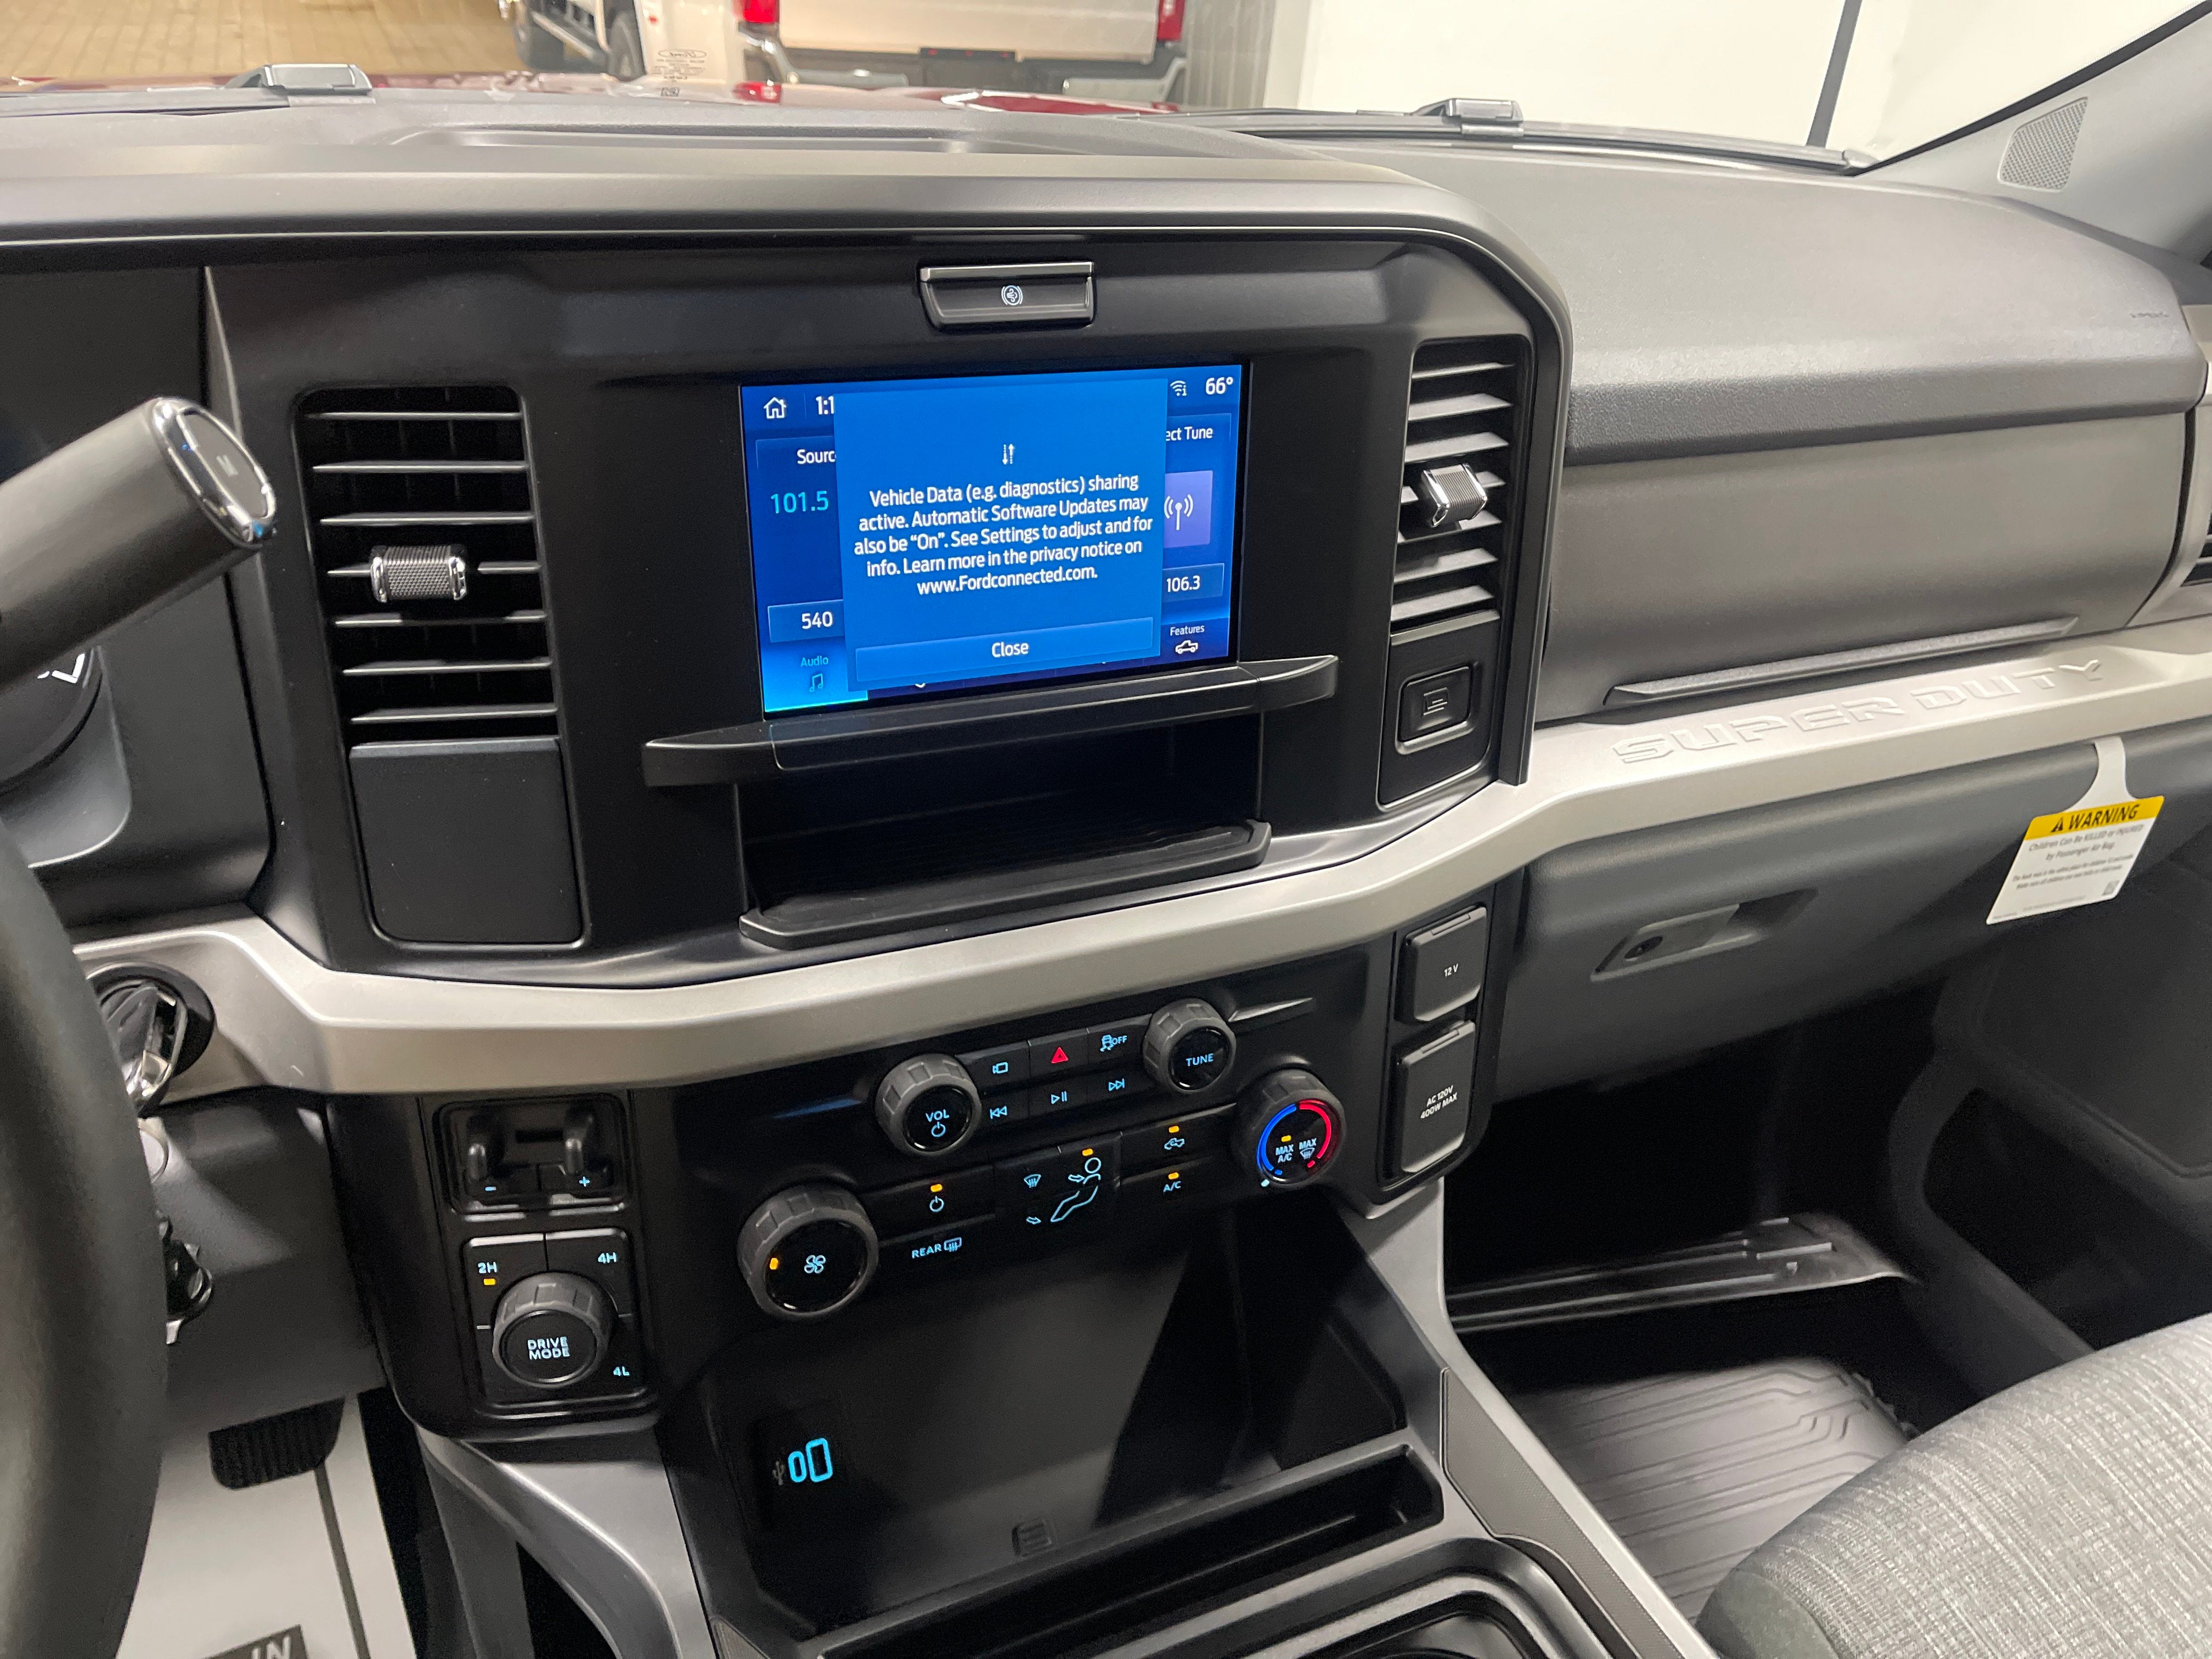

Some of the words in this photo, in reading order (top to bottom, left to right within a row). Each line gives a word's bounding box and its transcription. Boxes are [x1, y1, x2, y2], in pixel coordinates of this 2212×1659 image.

[1205, 376, 1234, 395] 66°
[1184, 426, 1214, 440] Tune
[797, 449, 836, 465] Sourc
[869, 487, 924, 507] Vehicle
[927, 485, 963, 504] Data
[966, 483, 997, 503] (e.g.
[1000, 476, 1085, 499] diagnostics)
[1088, 473, 1139, 492] sharing
[771, 490, 829, 514] 101.5
[859, 514, 909, 532] active.
[911, 507, 989, 528] Automatic
[991, 502, 1057, 522] Software
[1059, 498, 1116, 518] Updates
[1119, 496, 1149, 512] may
[854, 538, 887, 555] also
[889, 535, 908, 552] be
[951, 531, 979, 548] See
[981, 526, 1040, 545] Settings
[1042, 524, 1058, 539] to
[1059, 520, 1103, 539] adjust
[1105, 516, 1131, 534] and
[1133, 516, 1154, 532] for
[867, 559, 901, 577] info.
[903, 557, 945, 574] Learn
[948, 555, 985, 571] more
[988, 550, 1001, 566] in
[1003, 548, 1028, 565] the
[1030, 545, 1079, 566] privacy
[1081, 541, 1123, 558] notice
[1125, 540, 1143, 554] on
[917, 566, 1098, 595] www.Fordconnected.com.
[1166, 575, 1201, 592] 106.3
[802, 611, 833, 630] 540
[1170, 625, 1205, 636] Features
[991, 641, 1029, 658] Close
[800, 655, 829, 668] Audio
[1611, 695, 1904, 764] SUPER
[1910, 659, 2102, 710] DUTY
[2068, 804, 2141, 831] WARNING
[1444, 967, 1453, 978] 12
[1453, 963, 1459, 973] V
[1112, 1035, 1127, 1045] OFF
[1186, 1053, 1215, 1067] TUNE
[1426, 1094, 1437, 1107] AC
[1437, 1084, 1453, 1101] 120V
[1420, 1102, 1442, 1119] 400W
[1442, 1092, 1458, 1108] MAX
[925, 1109, 950, 1122] VOL
[1276, 1144, 1294, 1155] MAX
[1299, 1137, 1317, 1150] MAX
[1278, 1153, 1293, 1164] A/C
[1163, 1180, 1182, 1193] A/C
[597, 1251, 618, 1264] 4H
[911, 1243, 942, 1259] REAR
[477, 1261, 498, 1274] 2H
[527, 1336, 567, 1350] DRIVE
[528, 1346, 571, 1360] MODE
[612, 1366, 630, 1376] 4L
